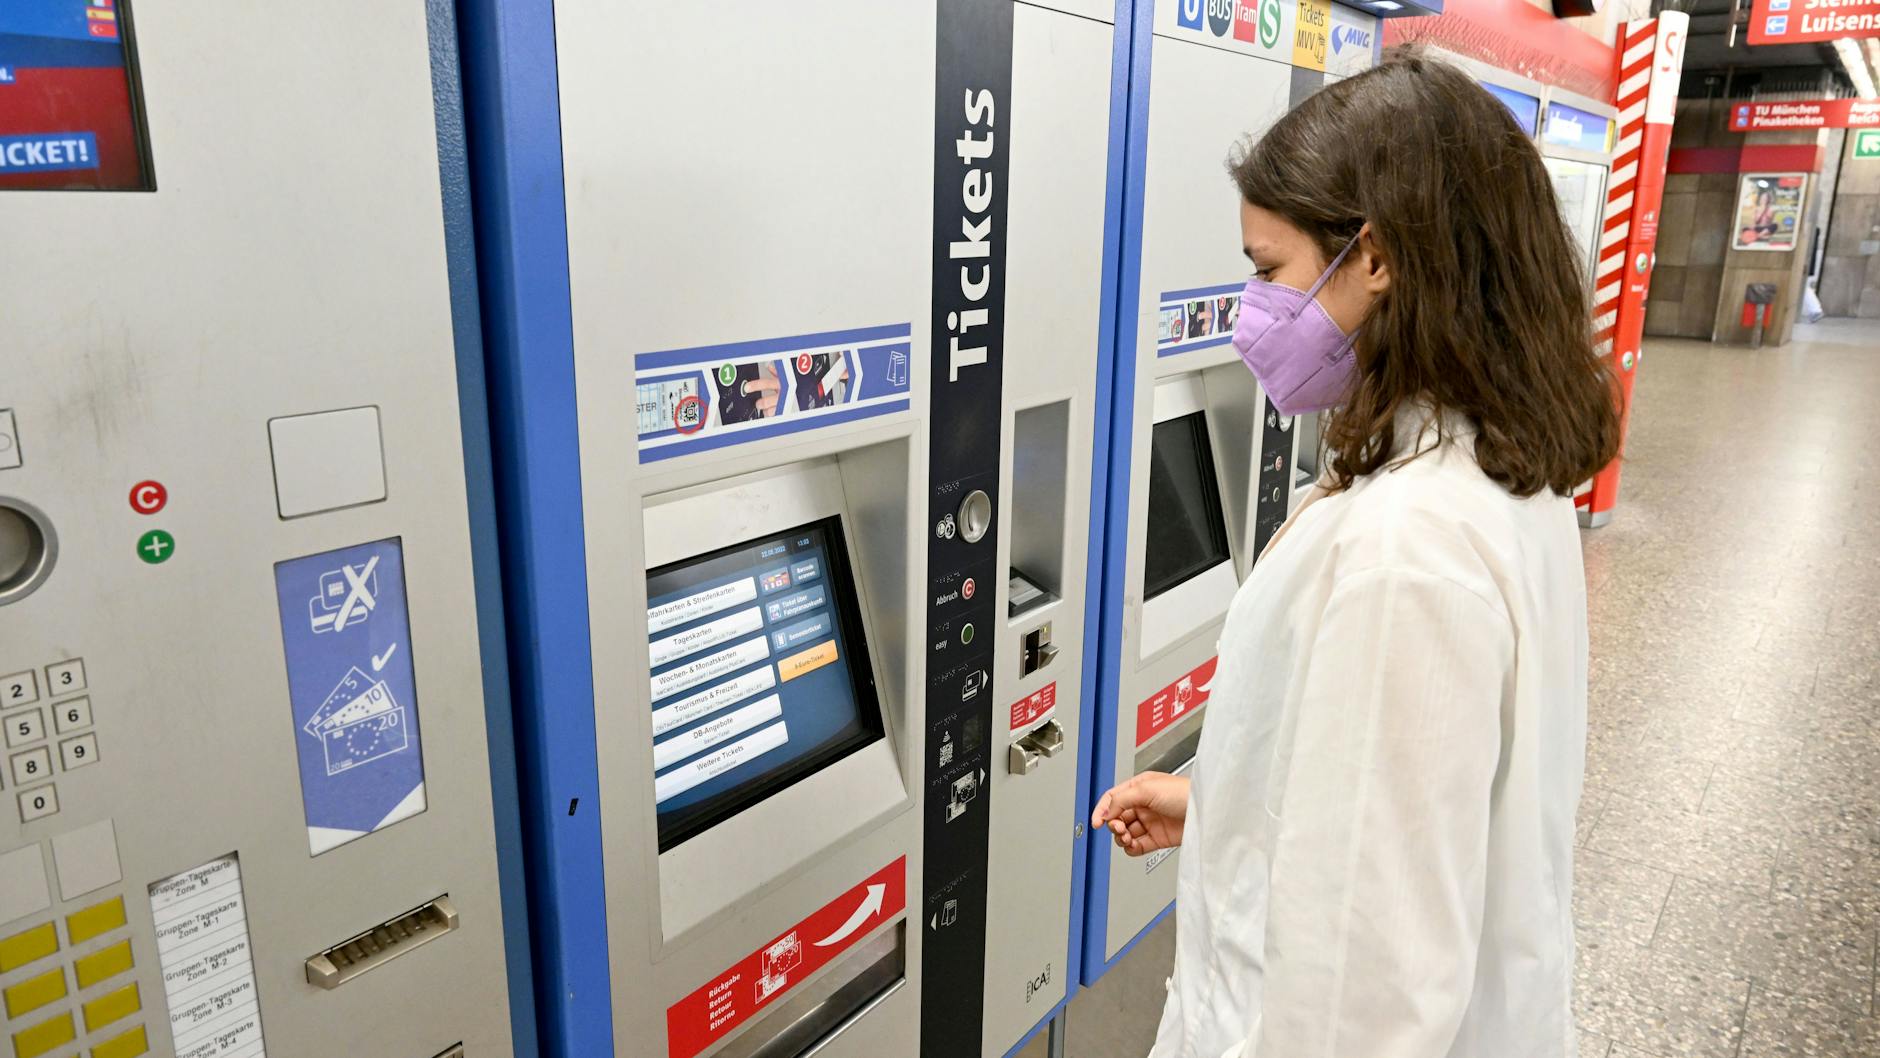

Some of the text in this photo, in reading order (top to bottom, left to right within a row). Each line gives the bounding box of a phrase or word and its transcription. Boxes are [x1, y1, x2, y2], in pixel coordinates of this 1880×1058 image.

[1184, 0, 1199, 21] U
[1208, 0, 1231, 20] BUS
[1236, 1, 1256, 24] Tram
[1300, 2, 1324, 27] Tickets
[1262, 0, 1279, 44] S
[1296, 29, 1316, 50] MVV
[1344, 28, 1370, 48] MVG
[1756, 104, 1820, 116] TU München
[1753, 114, 1824, 127] Pinakotheken
[947, 88, 994, 382] Tickets
[801, 356, 808, 368] 2
[724, 367, 732, 380] 1
[137, 486, 160, 508] C
[693, 586, 736, 604] Streifenkarten
[936, 590, 959, 607] Abbruch
[673, 628, 712, 646] Tageskarten
[935, 640, 948, 651] easy
[61, 671, 72, 685] 3
[658, 670, 688, 685] Wochen-
[696, 651, 737, 671] Monatskarten
[10, 684, 23, 698] 2
[344, 676, 357, 690] 5
[365, 688, 382, 705] 10
[674, 696, 709, 713] Tourismus
[716, 683, 738, 697] Freizeit
[68, 709, 79, 722] 6
[377, 712, 398, 731] 20
[18, 722, 30, 736] 5
[693, 717, 734, 740] DB-Angebote
[74, 745, 85, 758] 9
[696, 755, 720, 772] Weitere
[722, 745, 744, 760] Tickets
[26, 760, 38, 774] 8
[34, 796, 45, 810] 0
[150, 861, 232, 896] Gruppen-Tageskarte
[176, 878, 208, 897] Zone M
[156, 901, 238, 938] Gruppen-Tageskarte
[178, 917, 219, 940] Zone M-1
[165, 942, 245, 982] Gruppen-Tageskarte
[187, 958, 228, 982] Zone M-2
[709, 973, 740, 999] Rückgabe
[171, 982, 250, 1022] Gruppen-Tageskarte
[193, 998, 233, 1022] Zone M-3
[709, 990, 732, 1010] Return
[710, 1000, 732, 1020] Retour
[710, 1010, 736, 1031] Ritorno
[221, 1038, 236, 1050] M-4
